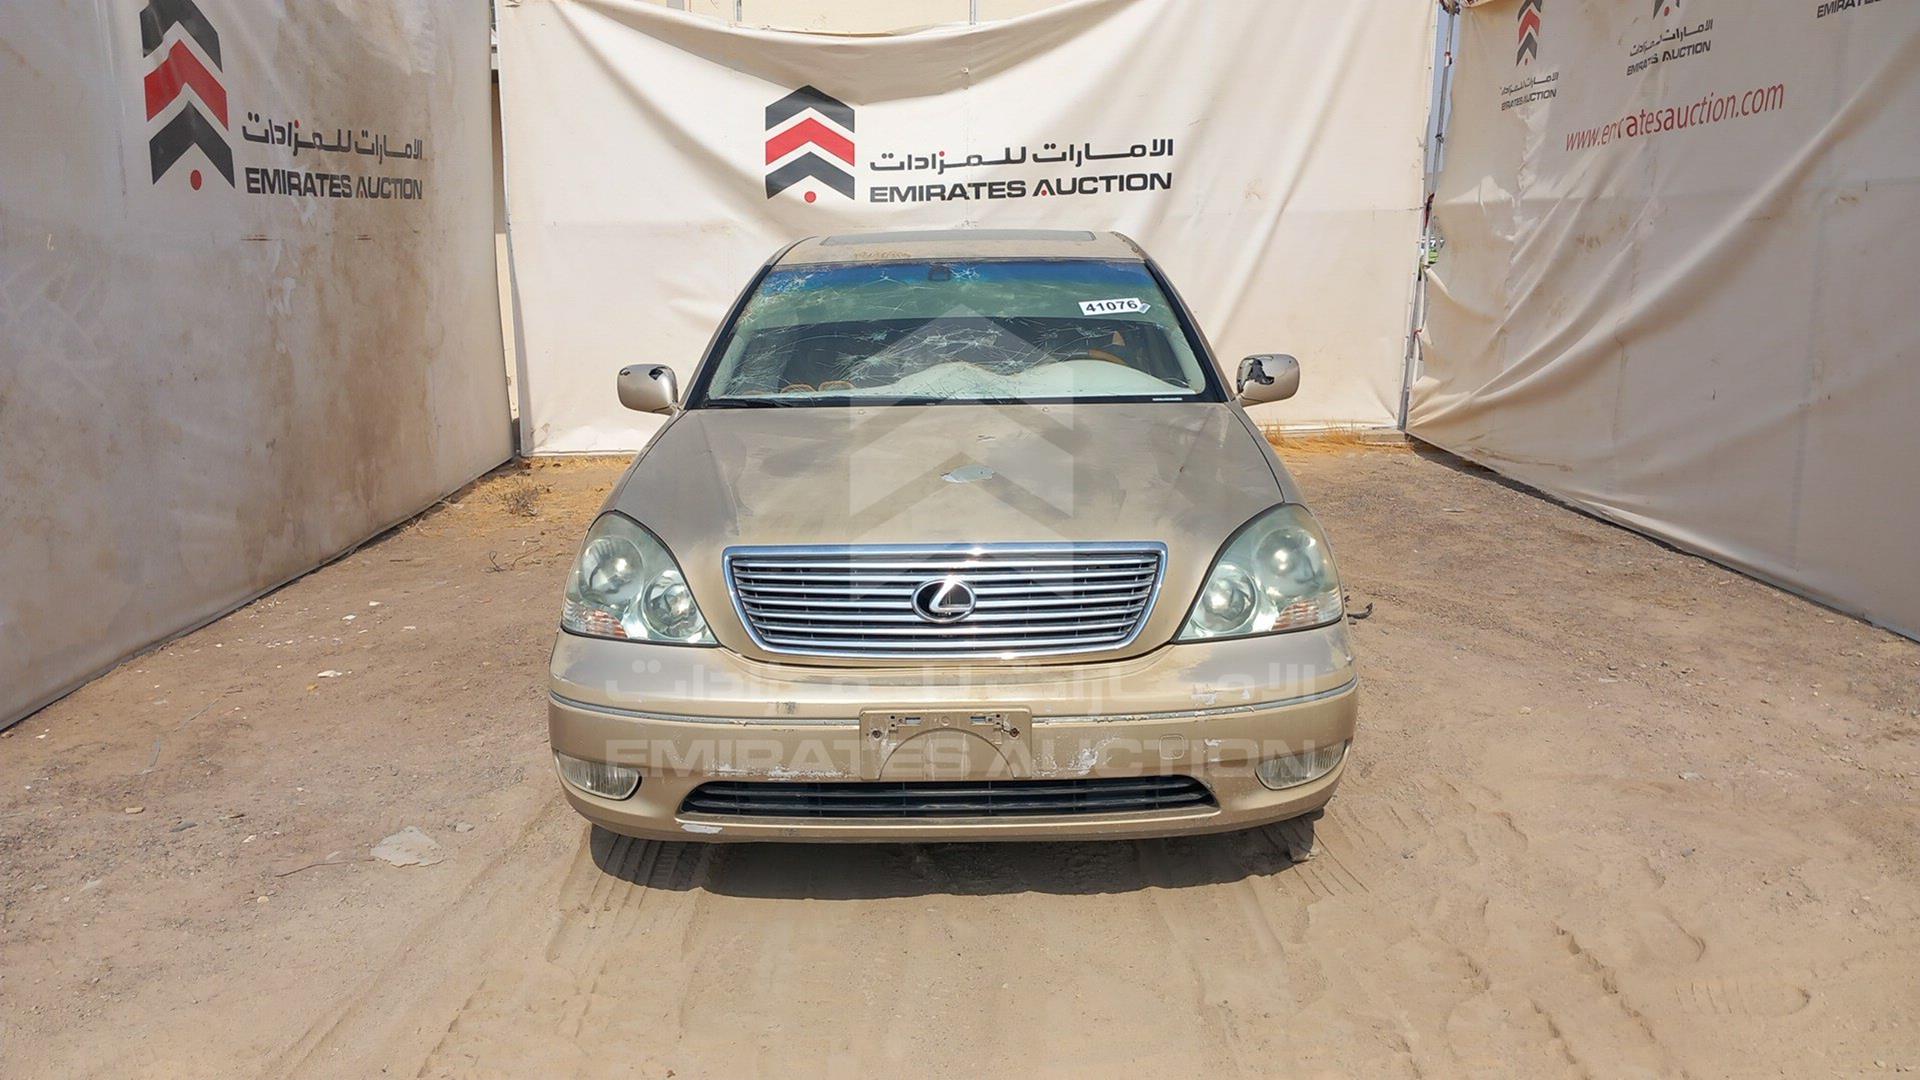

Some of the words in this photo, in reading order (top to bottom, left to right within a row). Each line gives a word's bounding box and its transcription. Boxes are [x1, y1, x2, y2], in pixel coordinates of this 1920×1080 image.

[1817, 0, 1881, 18] EMIRA
[1662, 40, 1712, 62] AUCTION
[242, 111, 351, 157] للمزادات
[354, 129, 423, 165] الامارات
[870, 146, 1027, 175] للمزادات
[1032, 138, 1174, 168] الامارات
[245, 166, 352, 199] EMIRATES
[355, 176, 423, 200] AUCTION
[869, 180, 1027, 203] EMIRATES
[1032, 172, 1173, 198] AUCTION
[1086, 300, 1138, 312] 41076
